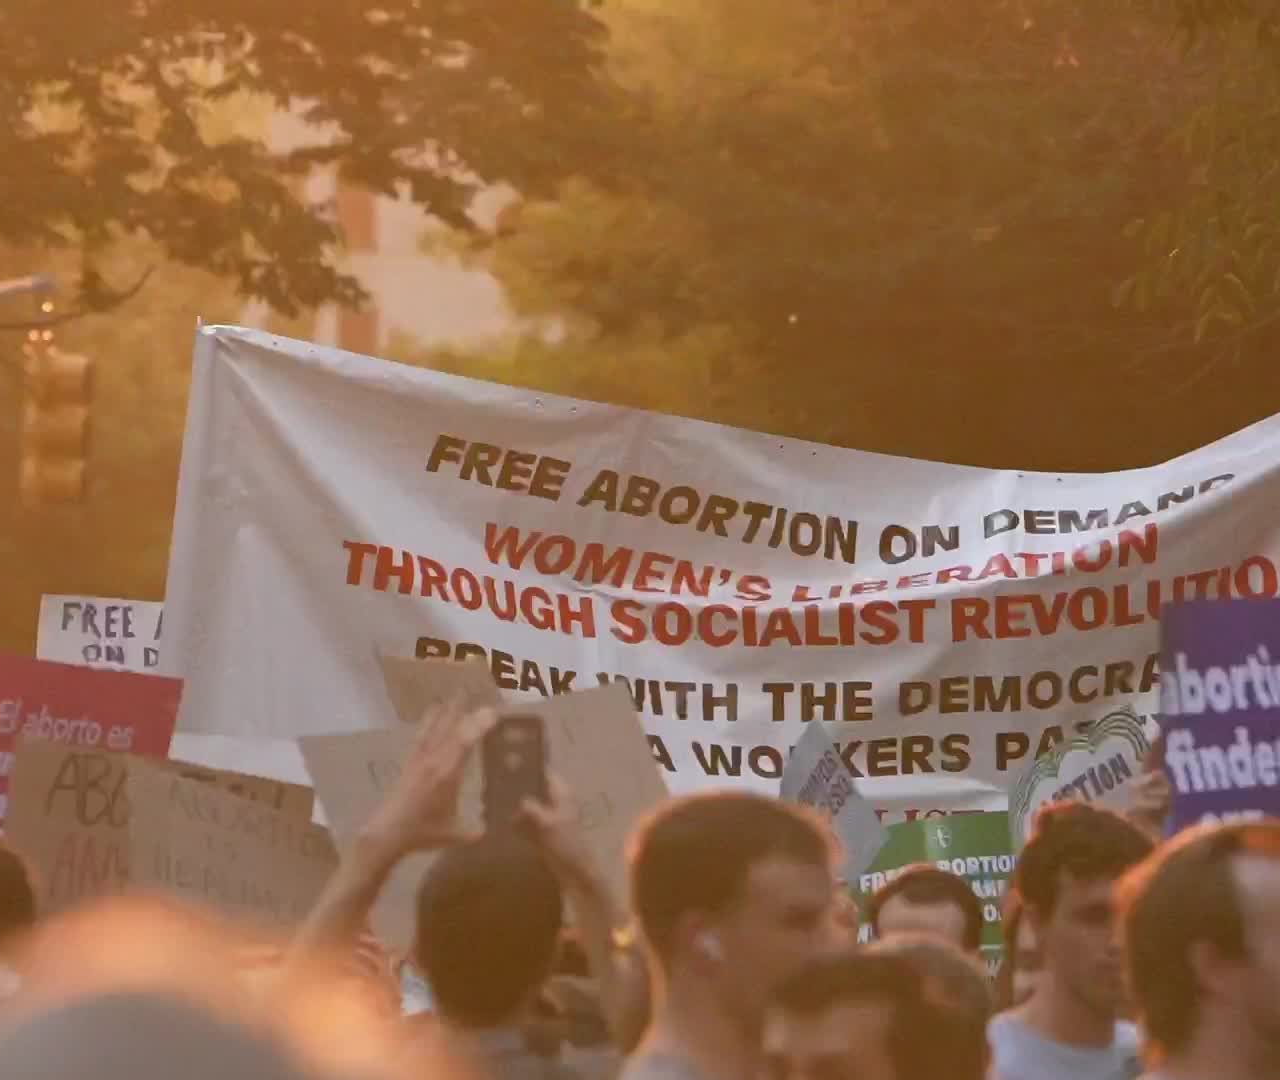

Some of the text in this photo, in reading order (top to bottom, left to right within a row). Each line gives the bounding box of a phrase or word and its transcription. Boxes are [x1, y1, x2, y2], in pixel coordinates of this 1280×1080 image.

[426, 434, 1236, 564] FREE ABORTION ON DEMAND
[483, 522, 1158, 603] WOMEN'S LIBERATION
[342, 540, 596, 639] THROUGH
[608, 598, 934, 646] SOCIALIST
[61, 602, 136, 639] FREE
[81, 644, 160, 667] ON D
[762, 681, 873, 721] THE
[23, 705, 101, 746] aborto
[105, 724, 136, 752] es
[691, 733, 970, 778] WOKERS
